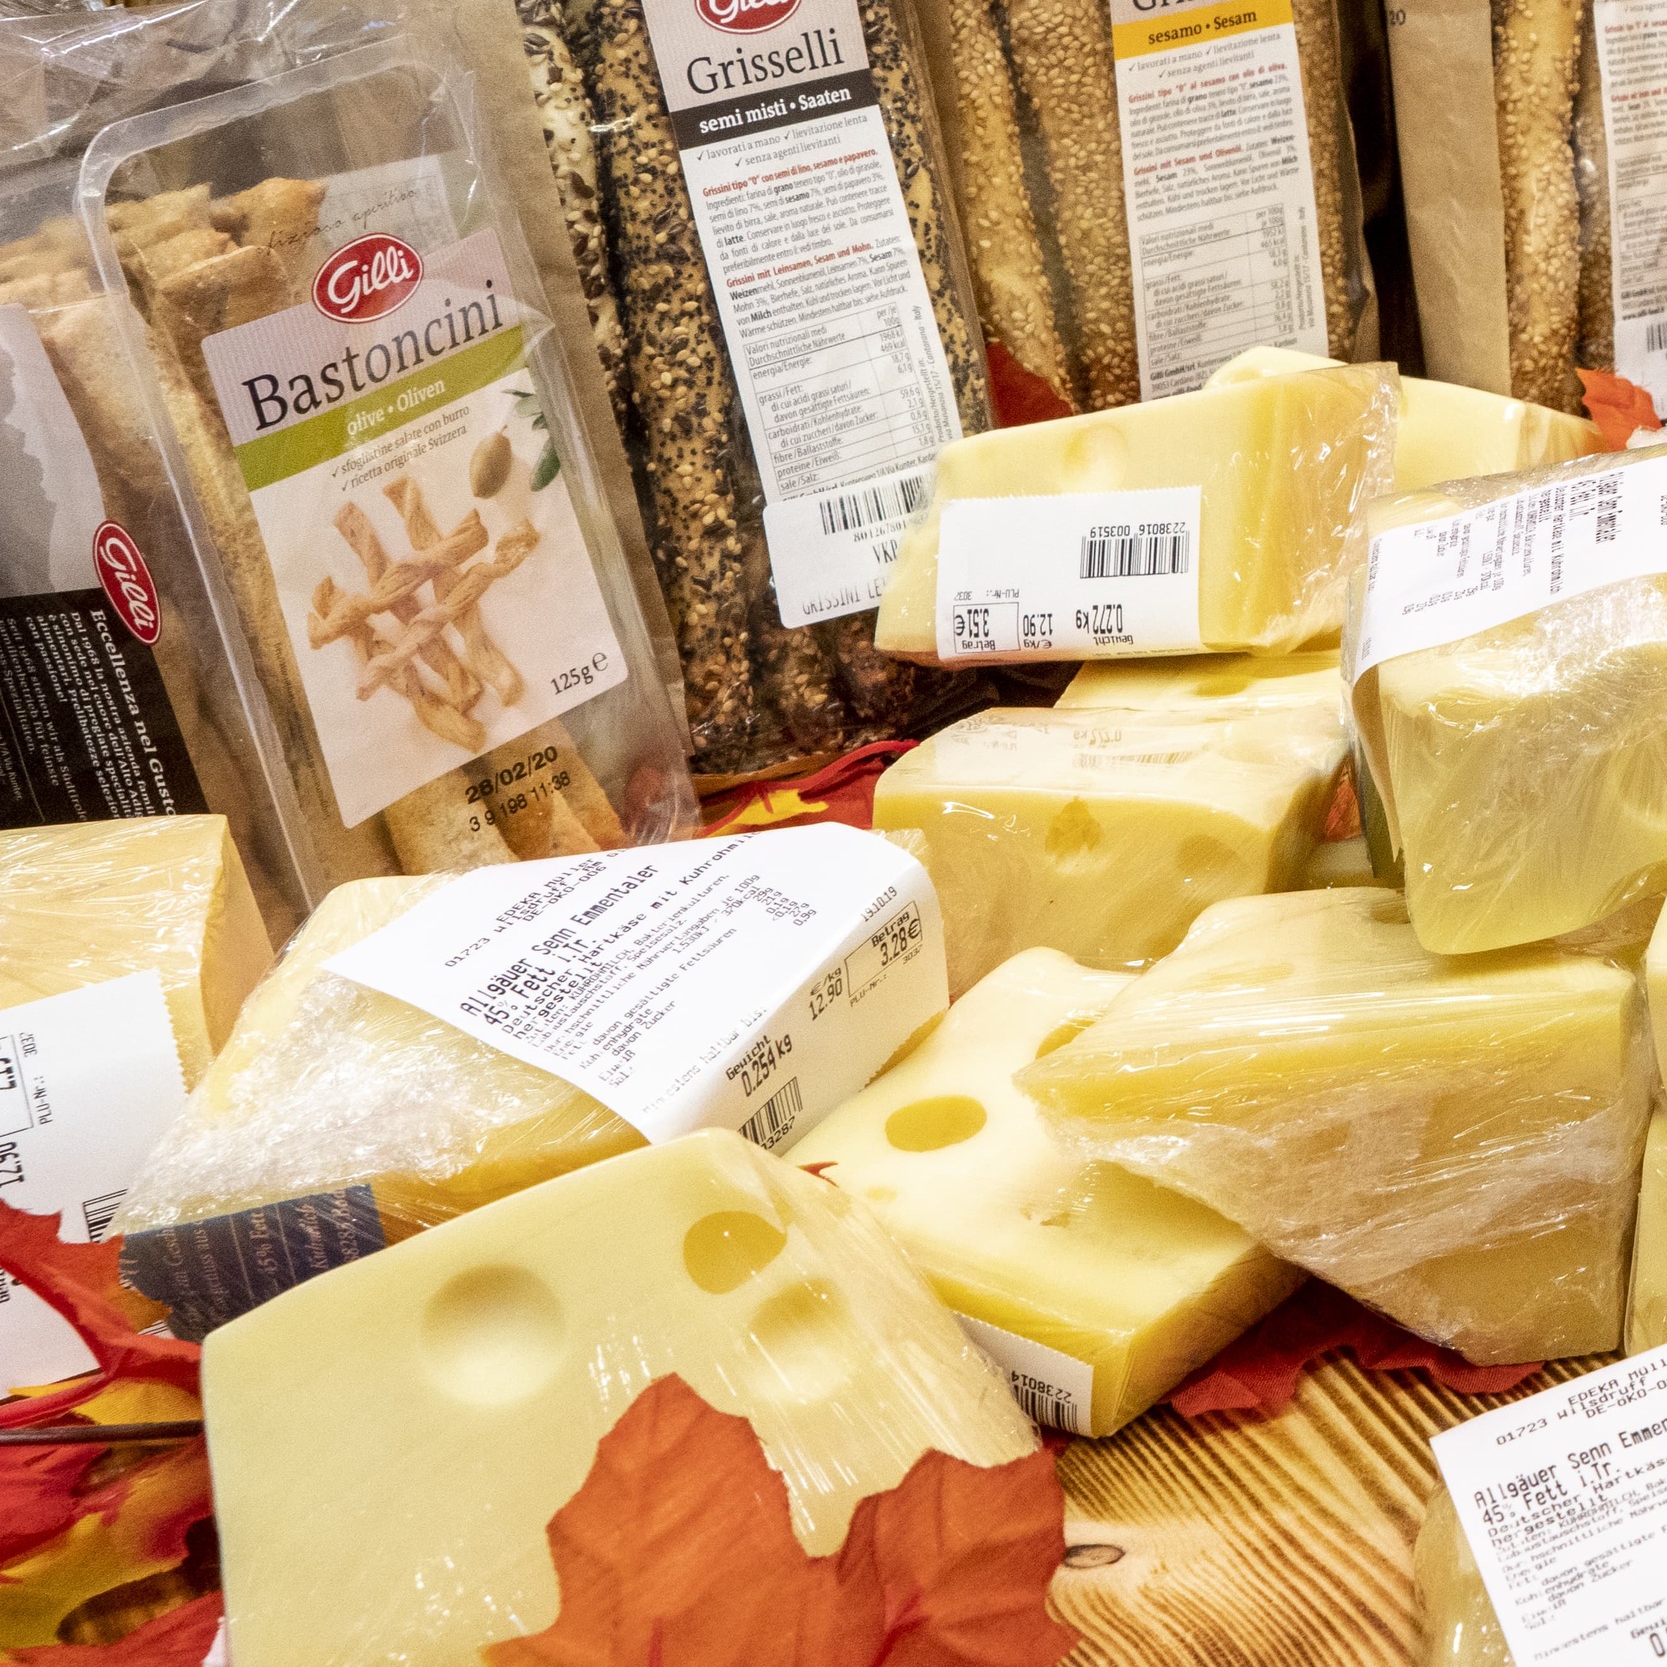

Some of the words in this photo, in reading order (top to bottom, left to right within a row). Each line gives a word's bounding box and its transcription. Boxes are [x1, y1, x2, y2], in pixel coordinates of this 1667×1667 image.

[1149, 24, 1202, 44] sesamo
[1214, 12, 1256, 30] Sesam
[687, 28, 844, 94] Grisselli
[700, 109, 743, 133] semi
[745, 99, 787, 122] misti
[799, 89, 851, 110] Saaten
[706, 142, 746, 159] lavorati
[754, 136, 780, 148] mano
[792, 121, 843, 139] lievitazione
[844, 116, 867, 126] lenta
[745, 154, 771, 165] senza
[770, 144, 799, 160] agenti
[800, 134, 840, 152] lievitanti
[320, 237, 418, 319] Gilli
[242, 280, 503, 431] Bastoncini
[348, 409, 384, 439] olive
[397, 380, 445, 412] Oliven
[442, 407, 469, 425] burro
[351, 466, 383, 488] ricetta
[428, 426, 467, 450] Svizzera
[1090, 525, 1130, 538] 003519
[1139, 522, 1185, 535] 2238016
[100, 529, 154, 637] Gilli
[987, 589, 1019, 598] PLU-Nr.:
[954, 609, 989, 638] 3.51€
[1023, 614, 1052, 637] 12.90
[1076, 610, 1089, 633] kg
[1093, 604, 1122, 634] 0.272
[962, 640, 995, 651] Betrag
[1094, 635, 1133, 646] Gewicht
[91, 610, 139, 715] Eccellenza
[135, 721, 156, 752] nel
[465, 747, 557, 804] 28/02/20
[470, 816, 480, 832] 3
[485, 808, 498, 825] 9
[461, 959, 536, 1015] Allgäuer
[532, 929, 575, 955] Senn
[571, 866, 657, 925] Emmentaler
[510, 967, 555, 998] Fett
[726, 1035, 770, 1080] Gewicht
[872, 912, 909, 947] Betrag
[742, 1047, 776, 1097] 0.254
[775, 1035, 792, 1058] kg
[810, 978, 842, 1020] 12.90
[1011, 1370, 1072, 1404] 2238014
[1568, 1380, 1618, 1405] EDEKA
[1497, 1419, 1547, 1445] 01723
[1558, 1377, 1644, 1419] Wilsdruff
[1475, 1465, 1556, 1506] Allgäuer
[1568, 1443, 1611, 1469] Senn
[1523, 1481, 1567, 1509] Fett
